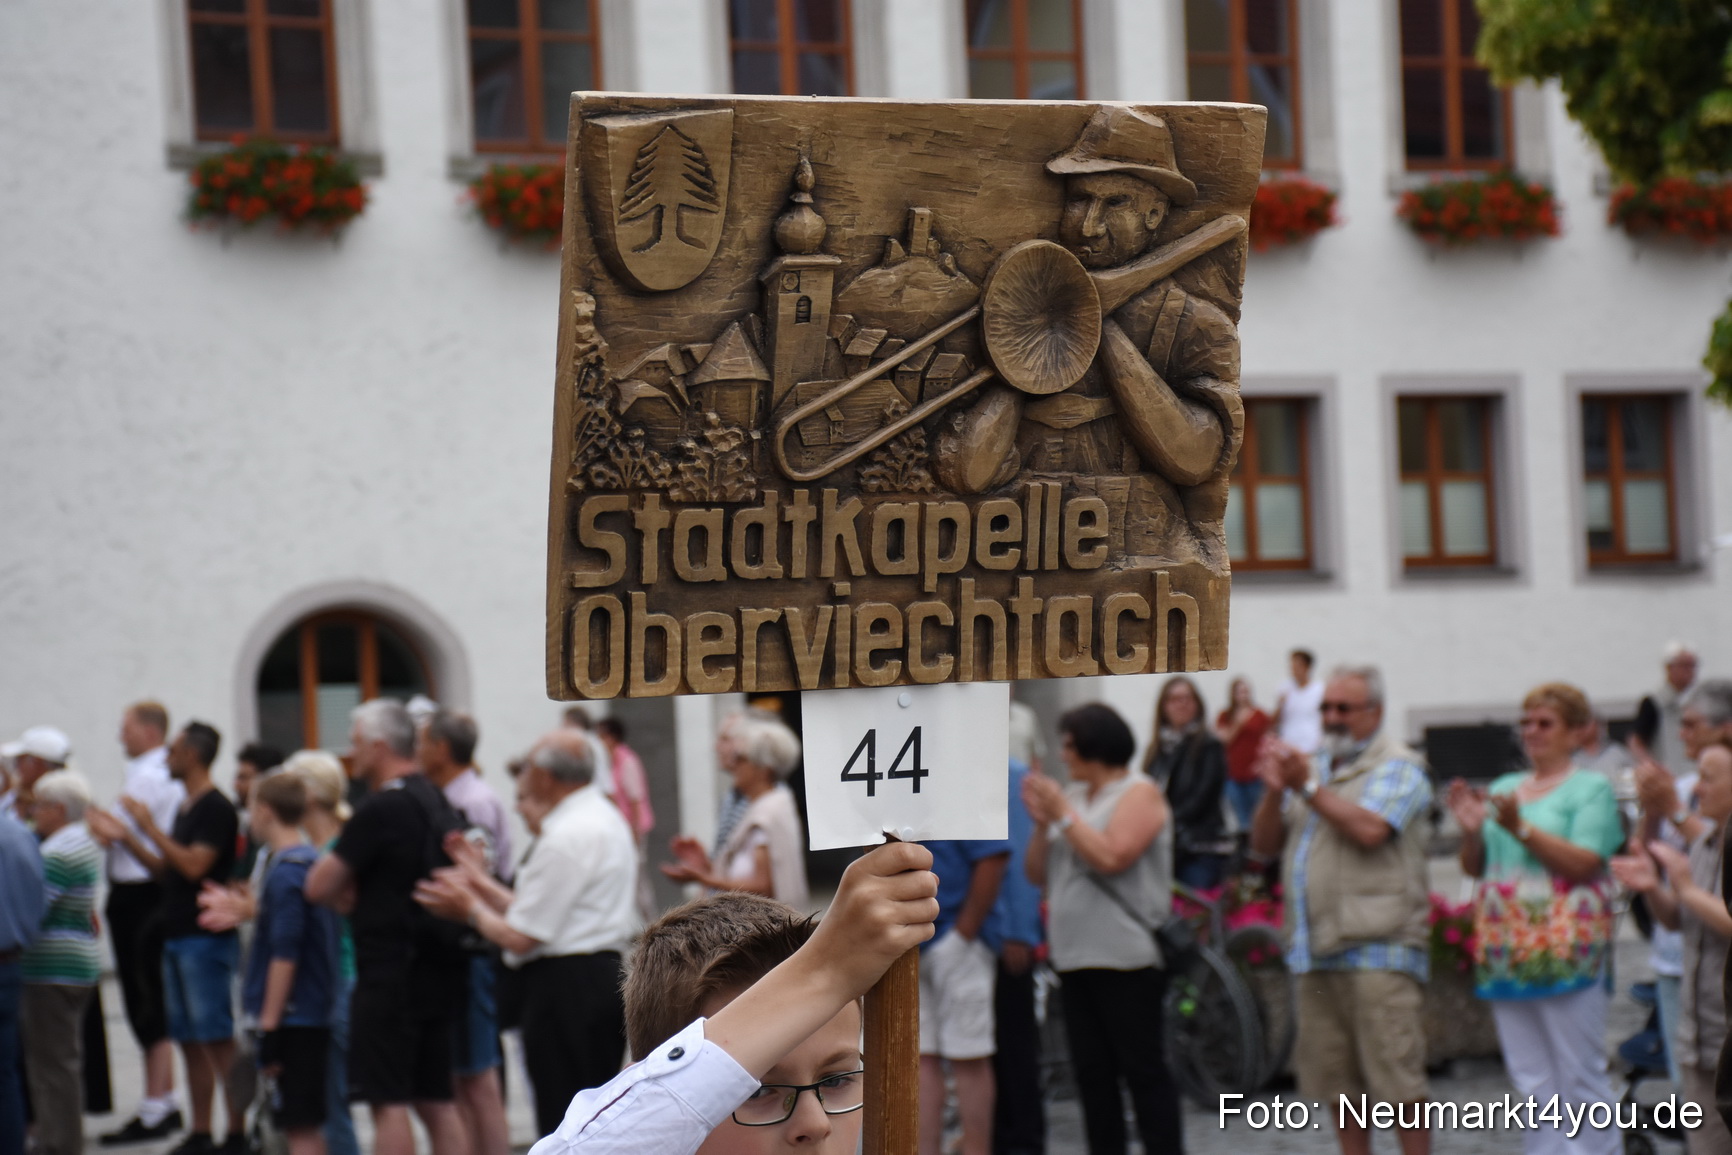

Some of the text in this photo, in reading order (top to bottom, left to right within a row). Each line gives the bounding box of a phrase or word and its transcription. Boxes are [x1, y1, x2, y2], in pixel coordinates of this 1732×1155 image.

[573, 482, 1110, 592] Stadtkapelle
[572, 570, 1201, 700] Oberviechtach
[840, 726, 929, 797] 44
